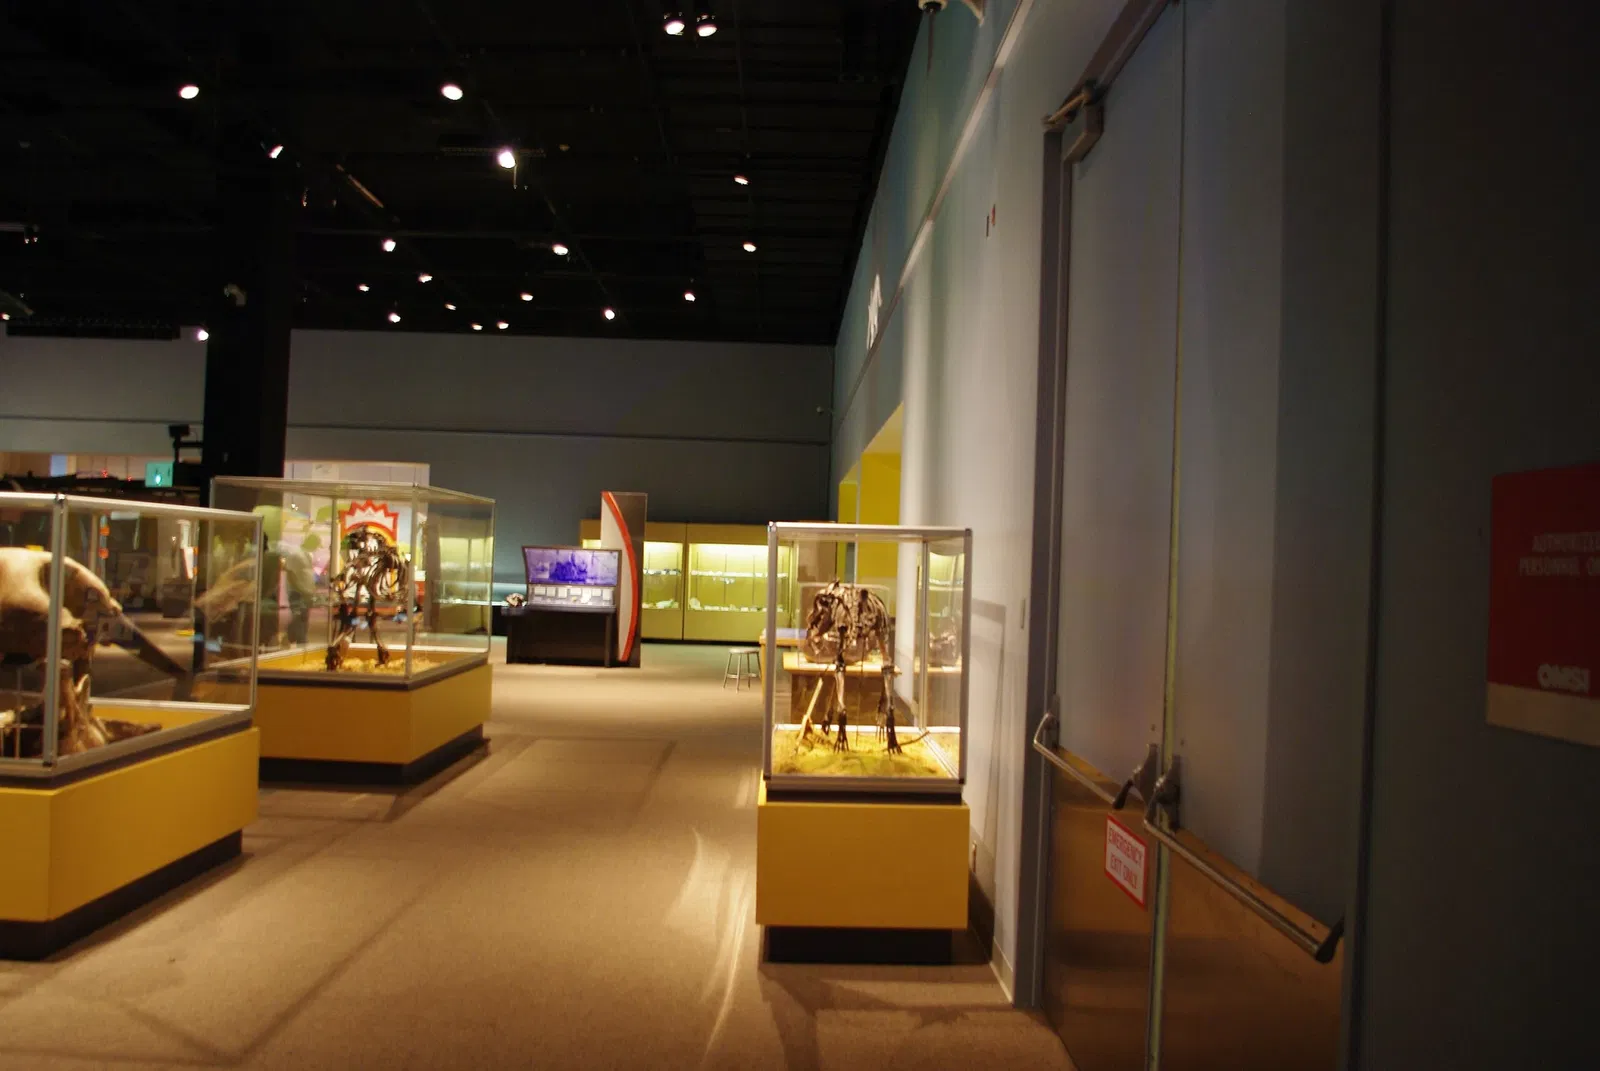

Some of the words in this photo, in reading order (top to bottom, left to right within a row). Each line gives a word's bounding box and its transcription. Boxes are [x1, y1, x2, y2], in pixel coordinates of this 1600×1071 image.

[1537, 664, 1589, 693] OMSI
[1108, 825, 1142, 868] EMERGENCY
[1110, 852, 1122, 878] EXIT
[1123, 864, 1138, 890] ONLY
